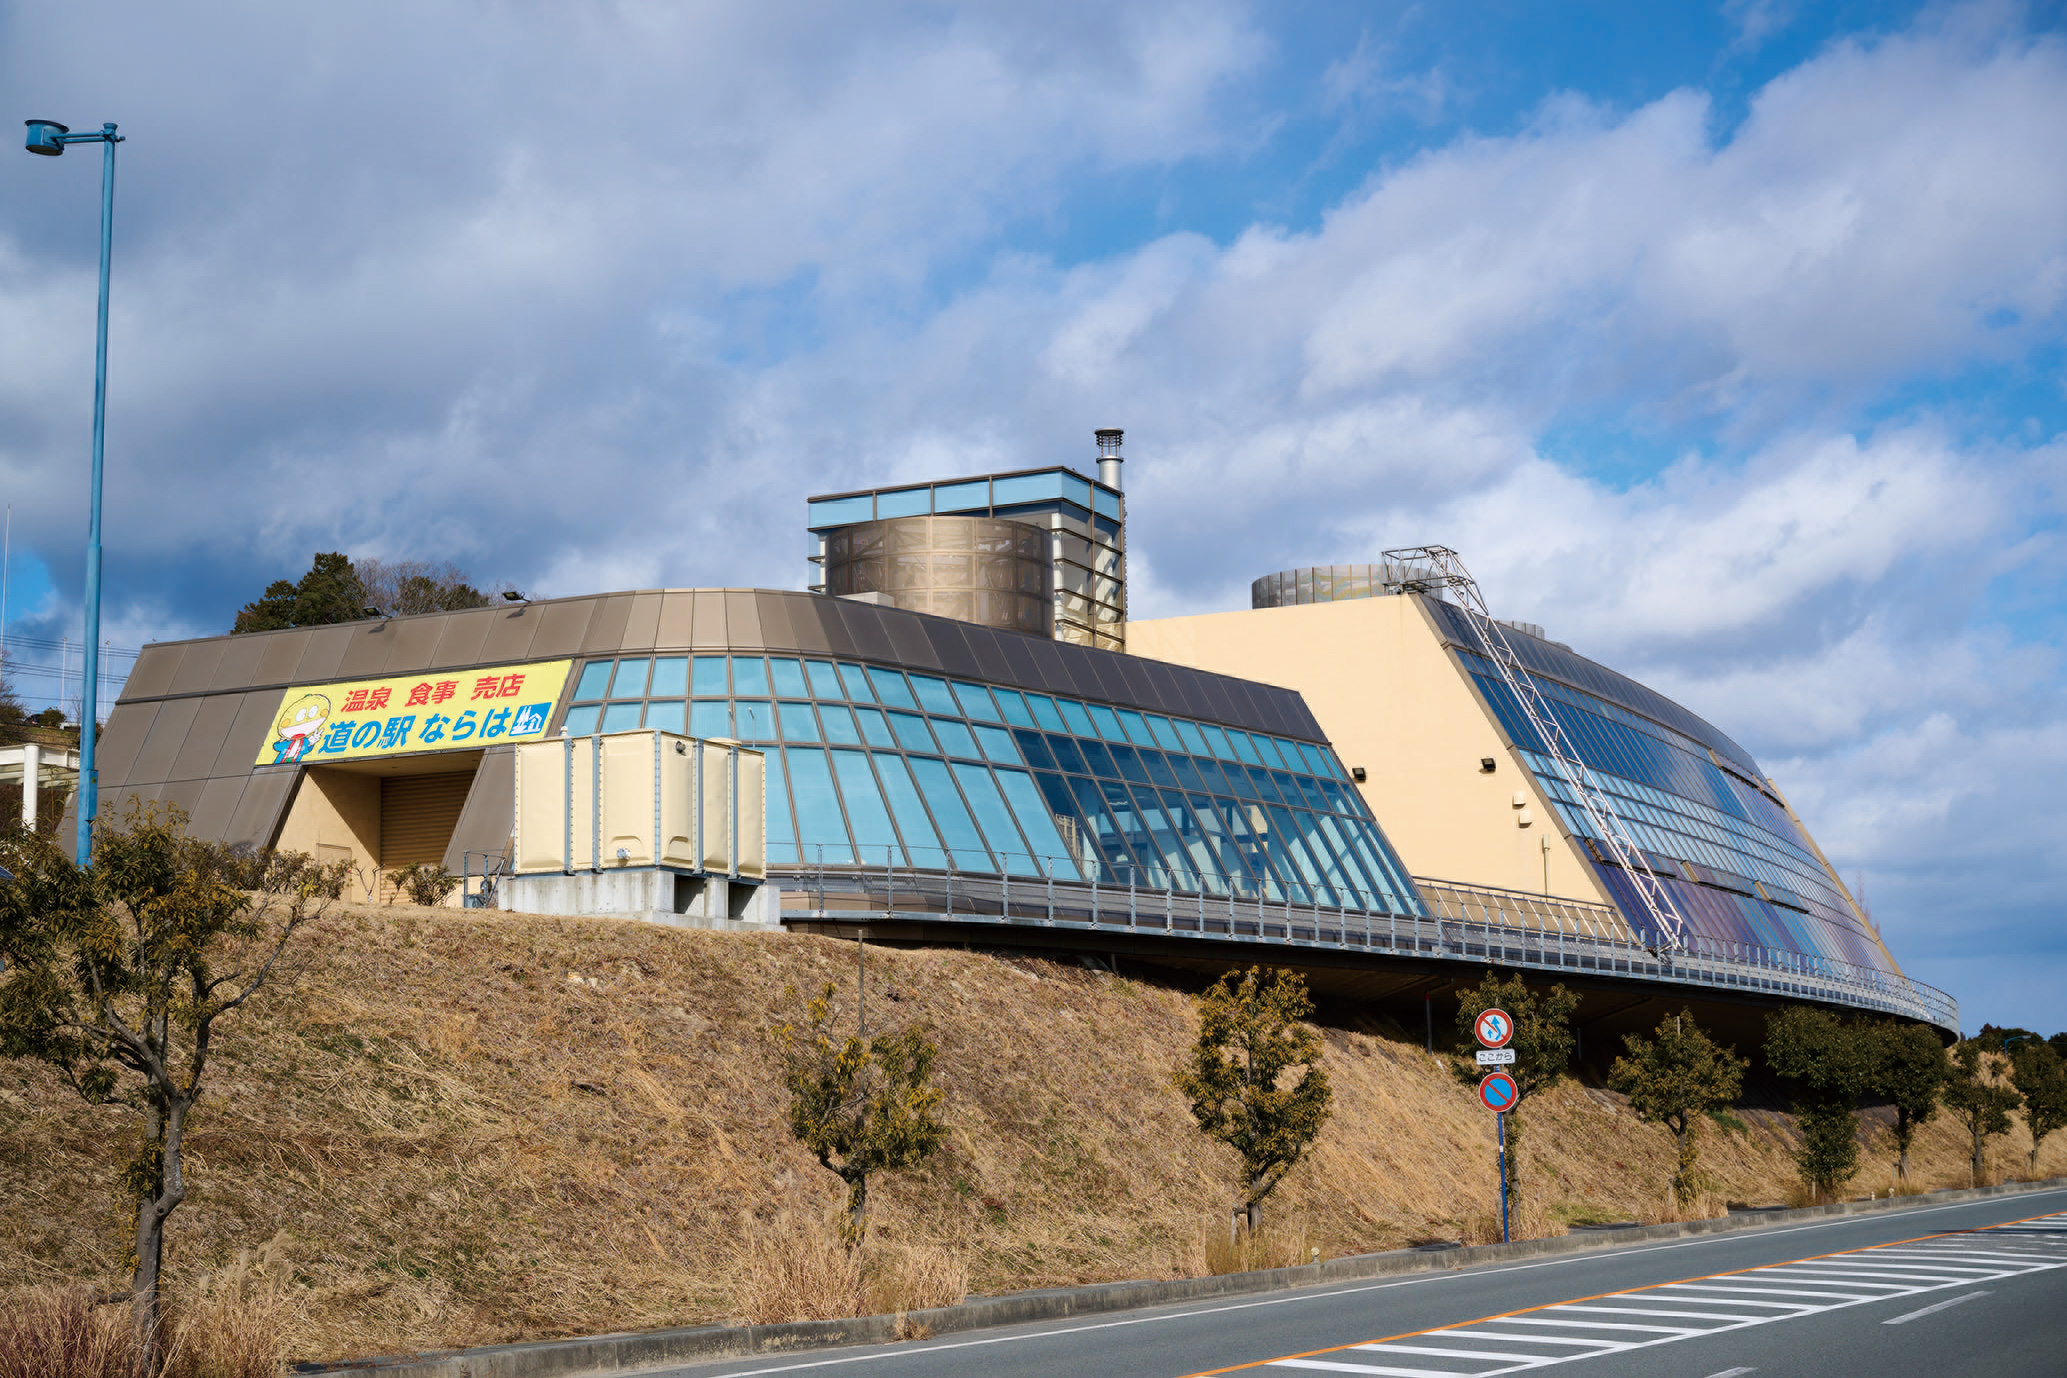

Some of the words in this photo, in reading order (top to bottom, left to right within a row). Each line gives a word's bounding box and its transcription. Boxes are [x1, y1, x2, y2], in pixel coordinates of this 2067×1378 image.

[341, 687, 393, 713] 温泉
[405, 680, 460, 707] 食事
[470, 673, 526, 701] 売店
[318, 714, 417, 754] 道の駅
[418, 706, 514, 744] ならは
[1479, 1052, 1512, 1062] ここから
